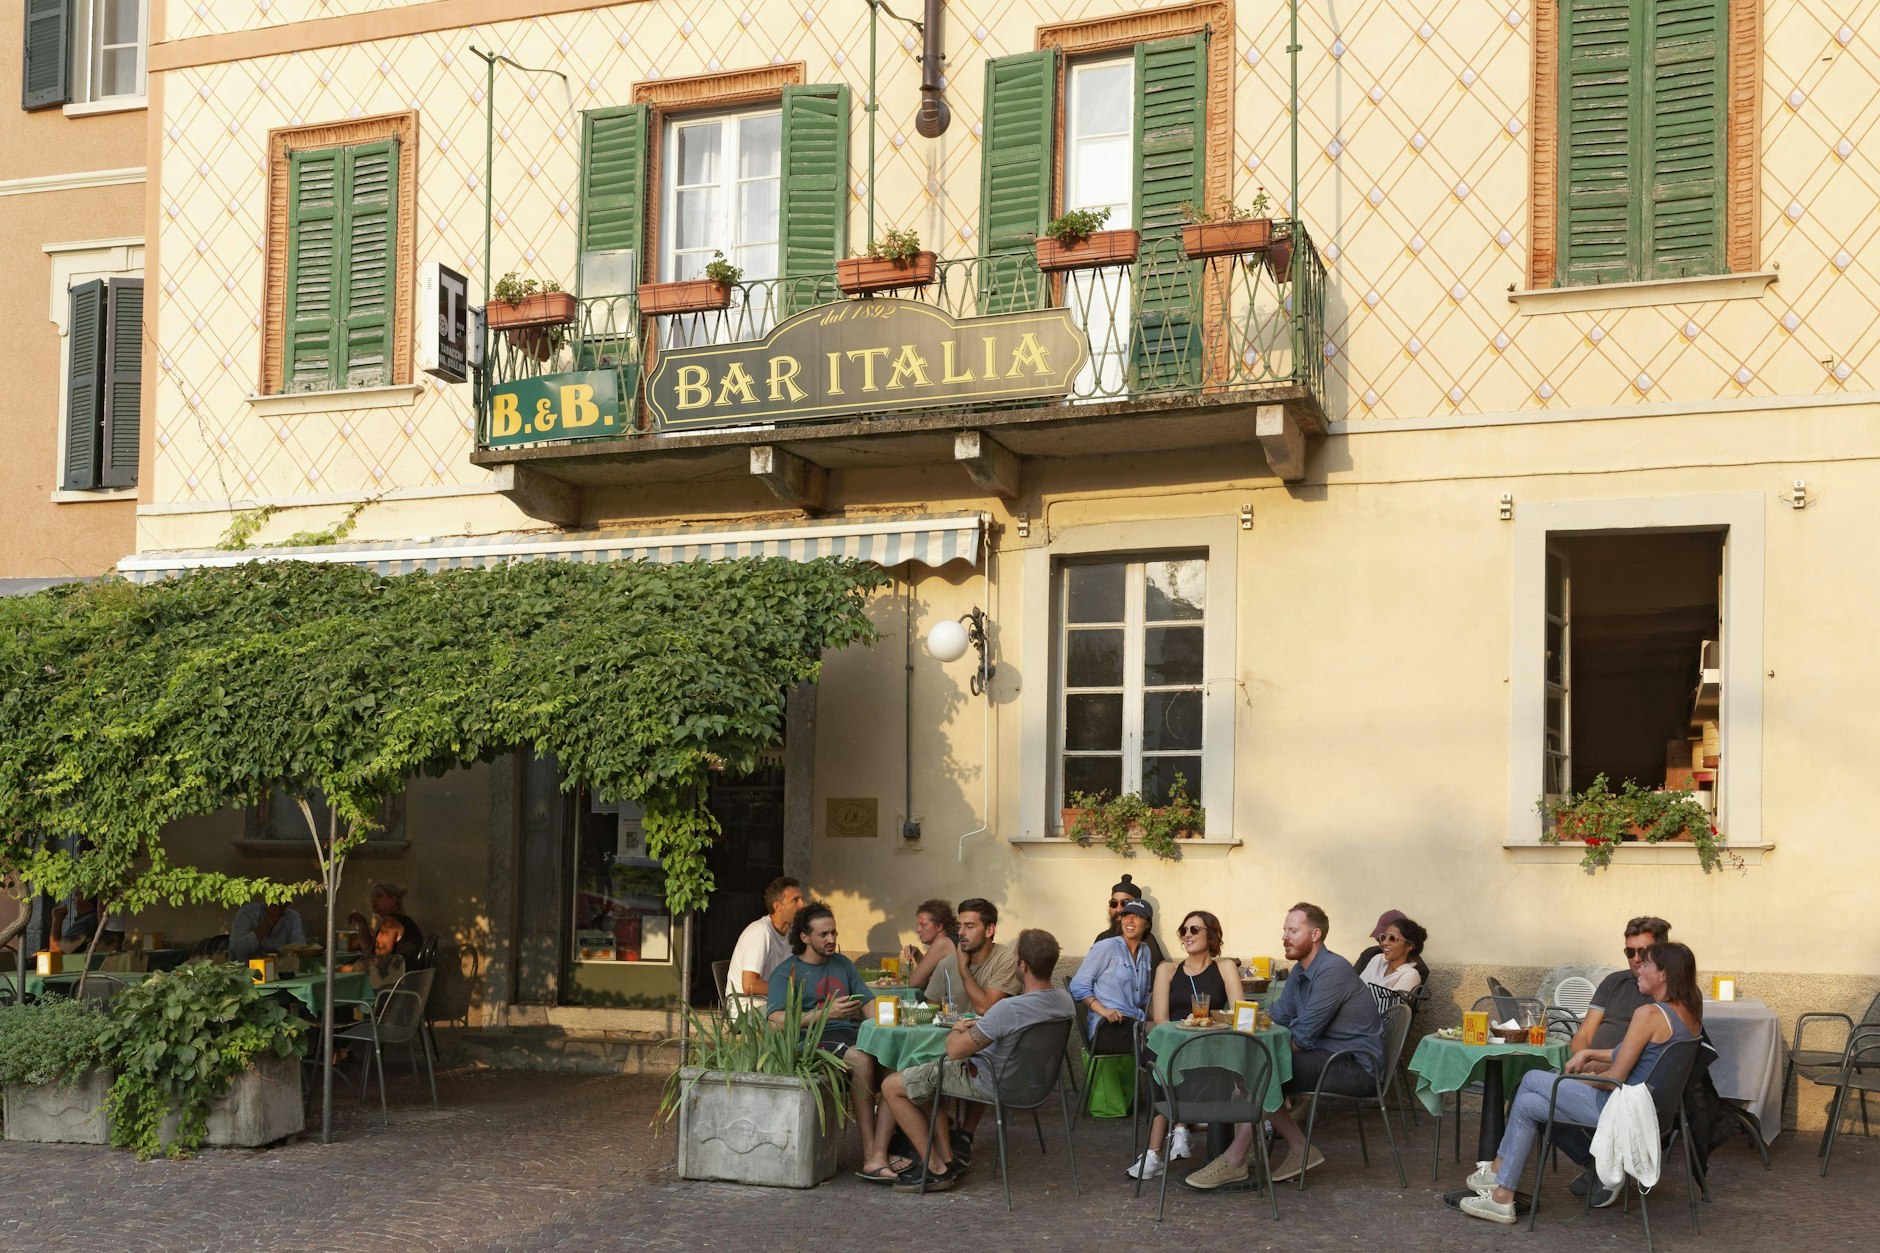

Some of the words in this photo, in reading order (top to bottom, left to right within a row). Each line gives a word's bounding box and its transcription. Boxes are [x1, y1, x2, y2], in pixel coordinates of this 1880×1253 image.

[441, 272, 464, 344] T
[820, 304, 851, 327] dal
[851, 304, 896, 320] 1892
[674, 355, 808, 410] BAR
[826, 332, 1056, 396] ITALIA
